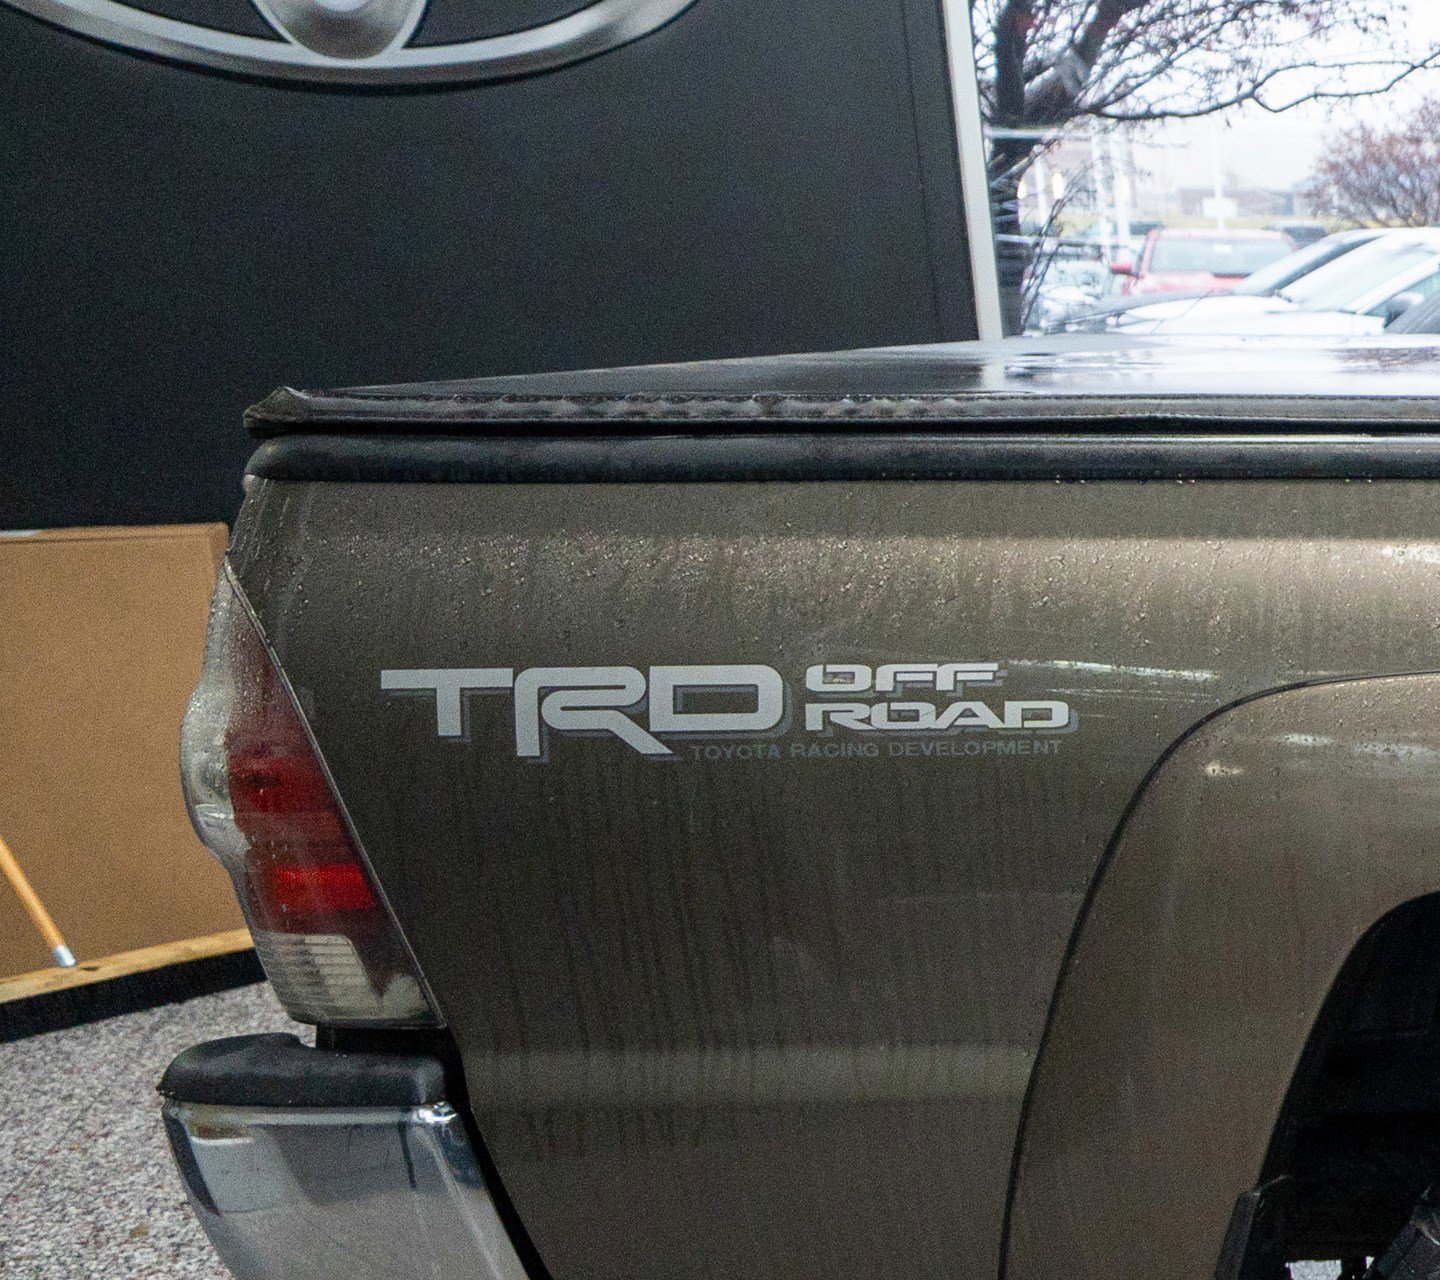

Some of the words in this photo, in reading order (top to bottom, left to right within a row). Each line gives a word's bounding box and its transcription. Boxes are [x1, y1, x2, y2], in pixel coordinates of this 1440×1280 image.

[805, 661, 1003, 695] OFF
[380, 663, 790, 761] TRD
[805, 699, 1077, 734] ROAD
[691, 743, 781, 761] TOYOTA
[790, 742, 880, 759] RACING
[889, 739, 1063, 758] DEVELOPMENT
